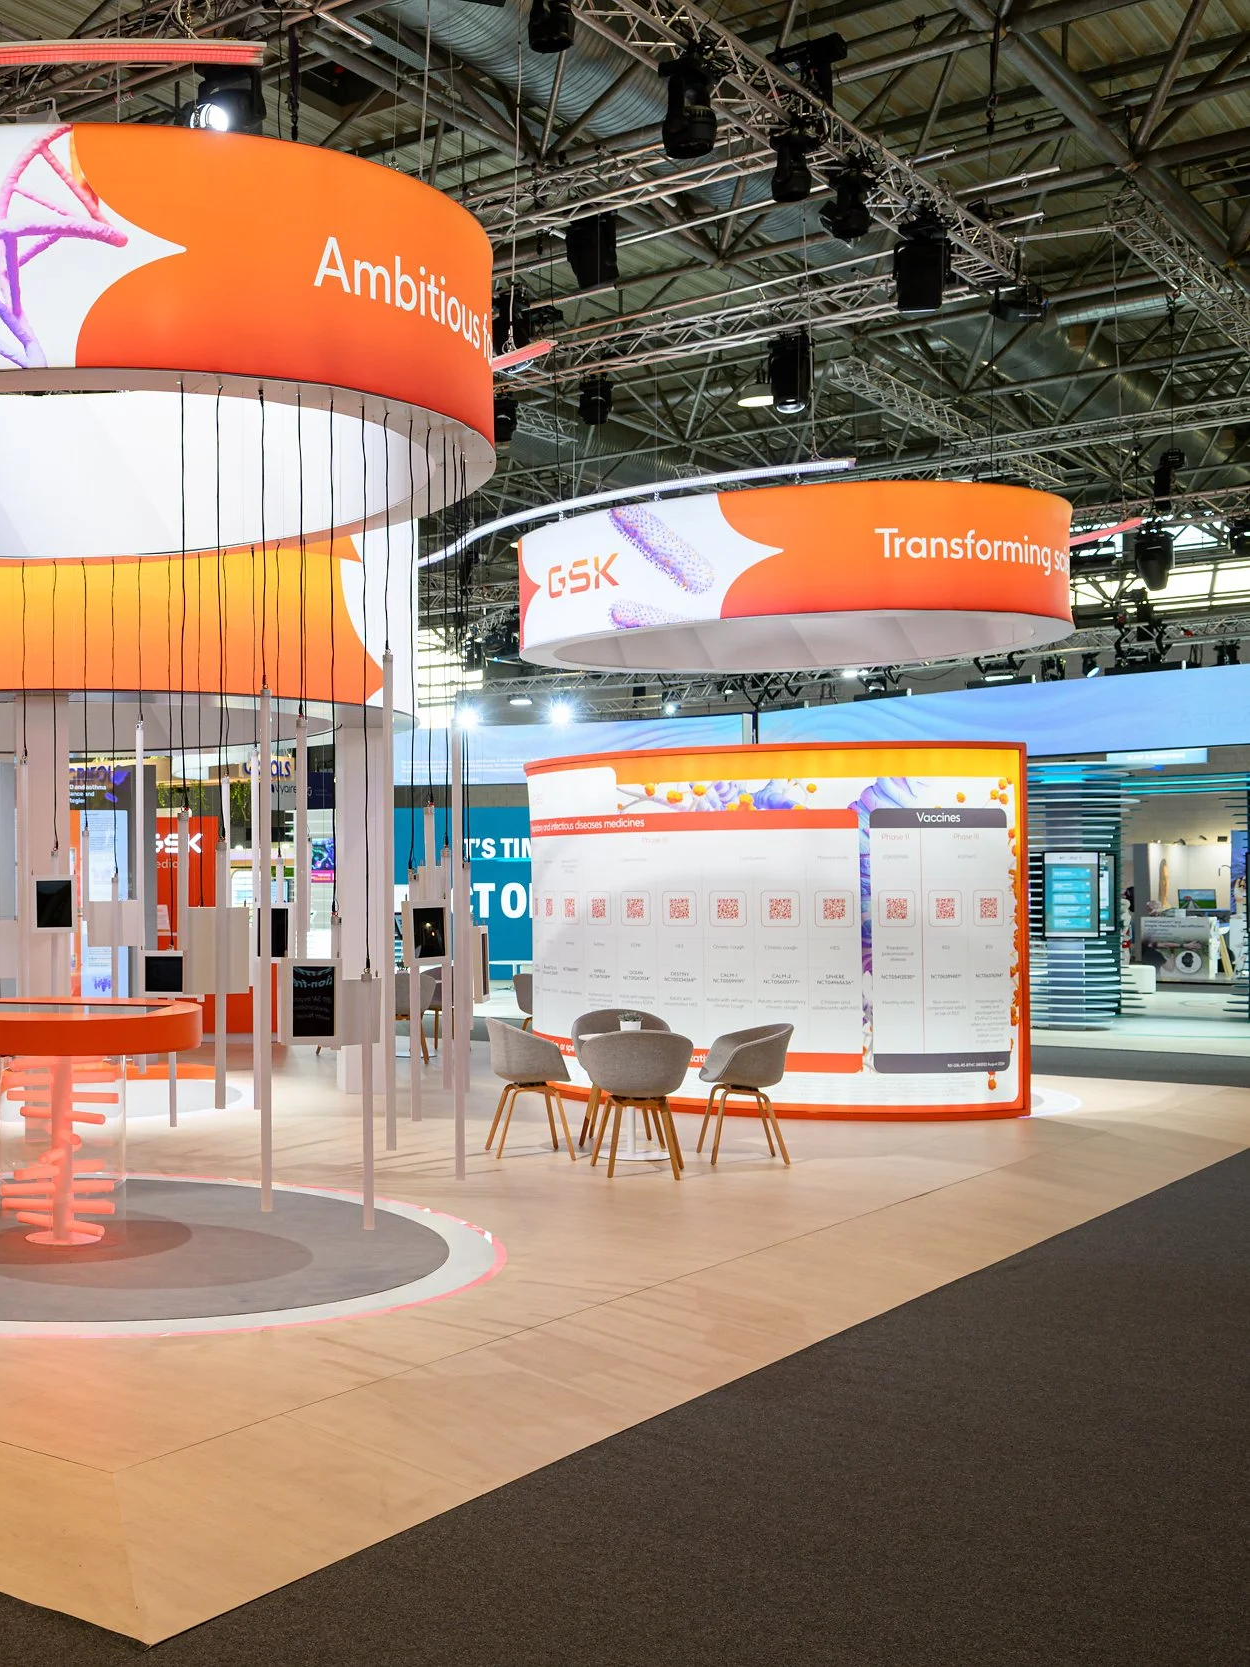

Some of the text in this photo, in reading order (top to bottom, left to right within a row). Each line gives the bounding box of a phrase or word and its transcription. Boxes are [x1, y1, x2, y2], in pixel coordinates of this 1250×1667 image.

[313, 236, 481, 350] Ambitious
[874, 528, 1051, 576] Transforming
[547, 552, 620, 600] GSK
[575, 820, 602, 829] diseases
[604, 818, 645, 828] medicines
[916, 812, 961, 823] Vaccines
[464, 837, 497, 859] T'S
[500, 882, 533, 919] O
